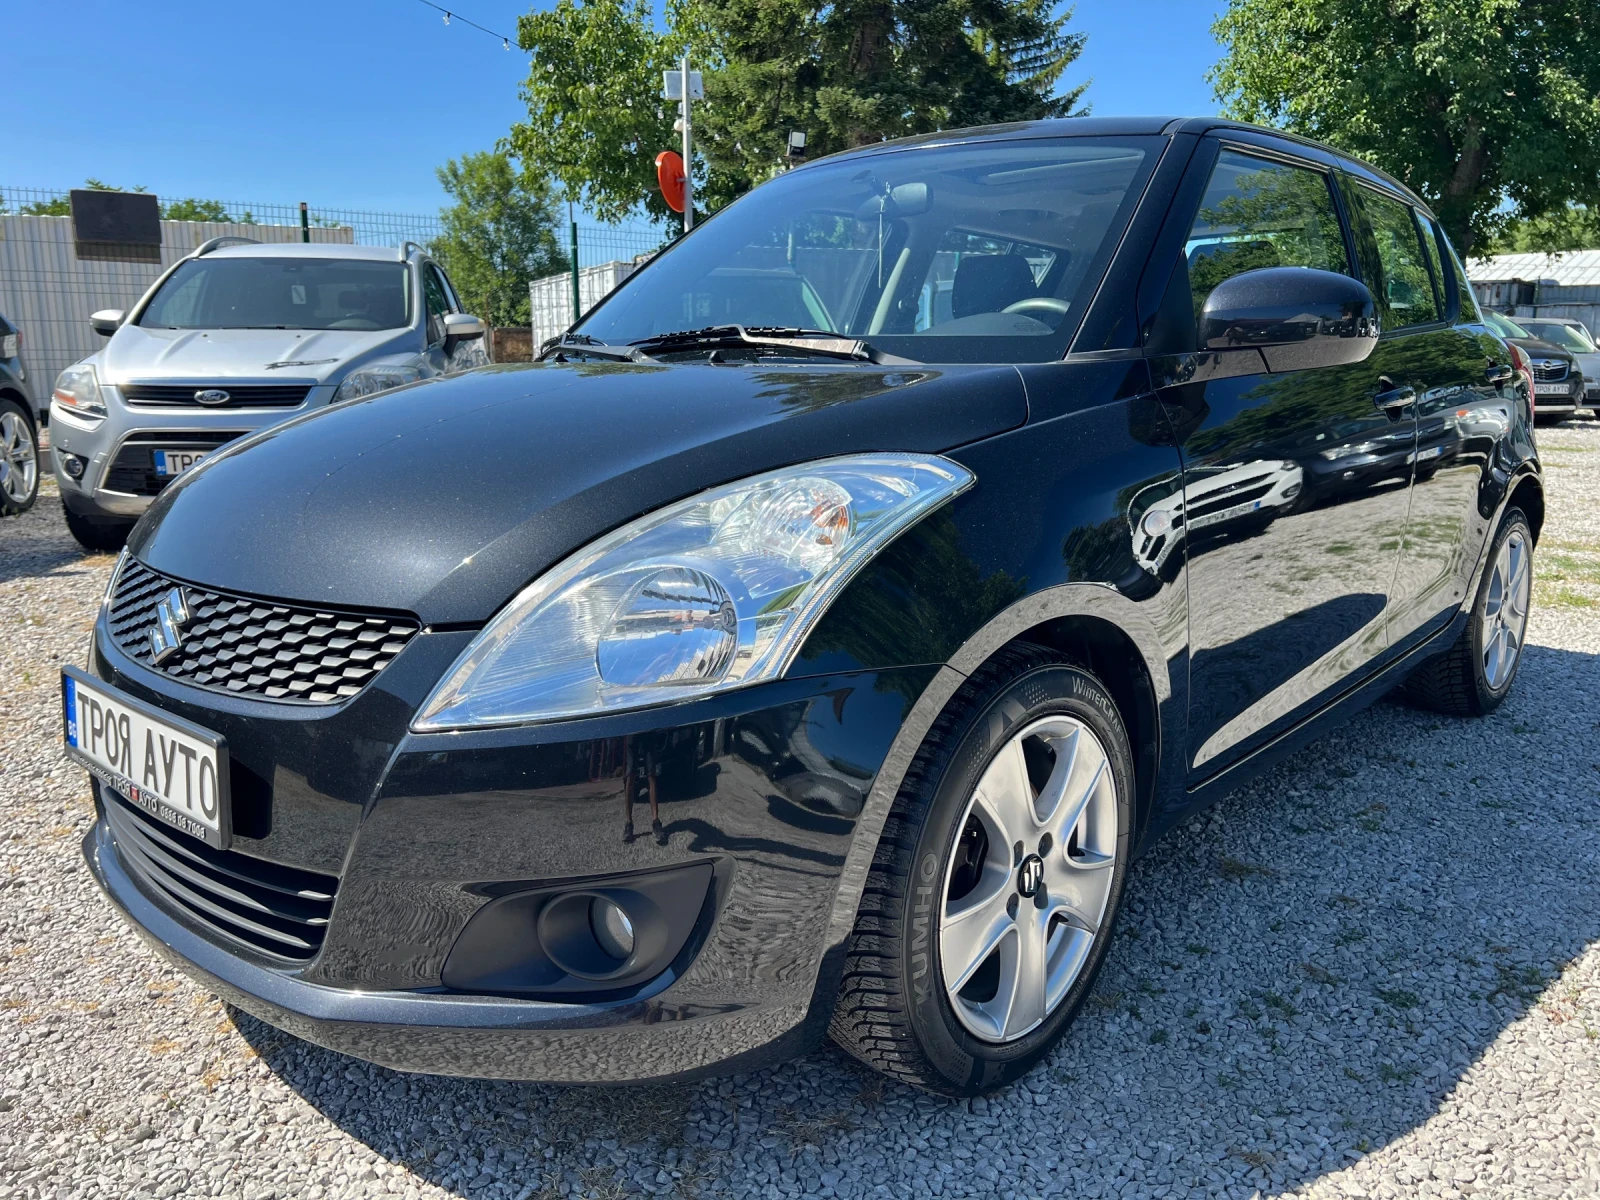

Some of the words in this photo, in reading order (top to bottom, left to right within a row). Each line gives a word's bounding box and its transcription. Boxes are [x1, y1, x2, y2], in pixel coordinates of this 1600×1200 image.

[202, 391, 221, 401] Ford
[1535, 385, 1551, 393] ТРОЯ
[1552, 386, 1569, 394] АУТО
[68, 719, 77, 739] BG
[77, 691, 132, 779] ТРОЯ
[143, 727, 219, 821] АУТО
[113, 774, 131, 797] ТРОЯ
[138, 791, 159, 813] АУТО
[911, 853, 938, 1005] KUMHO
